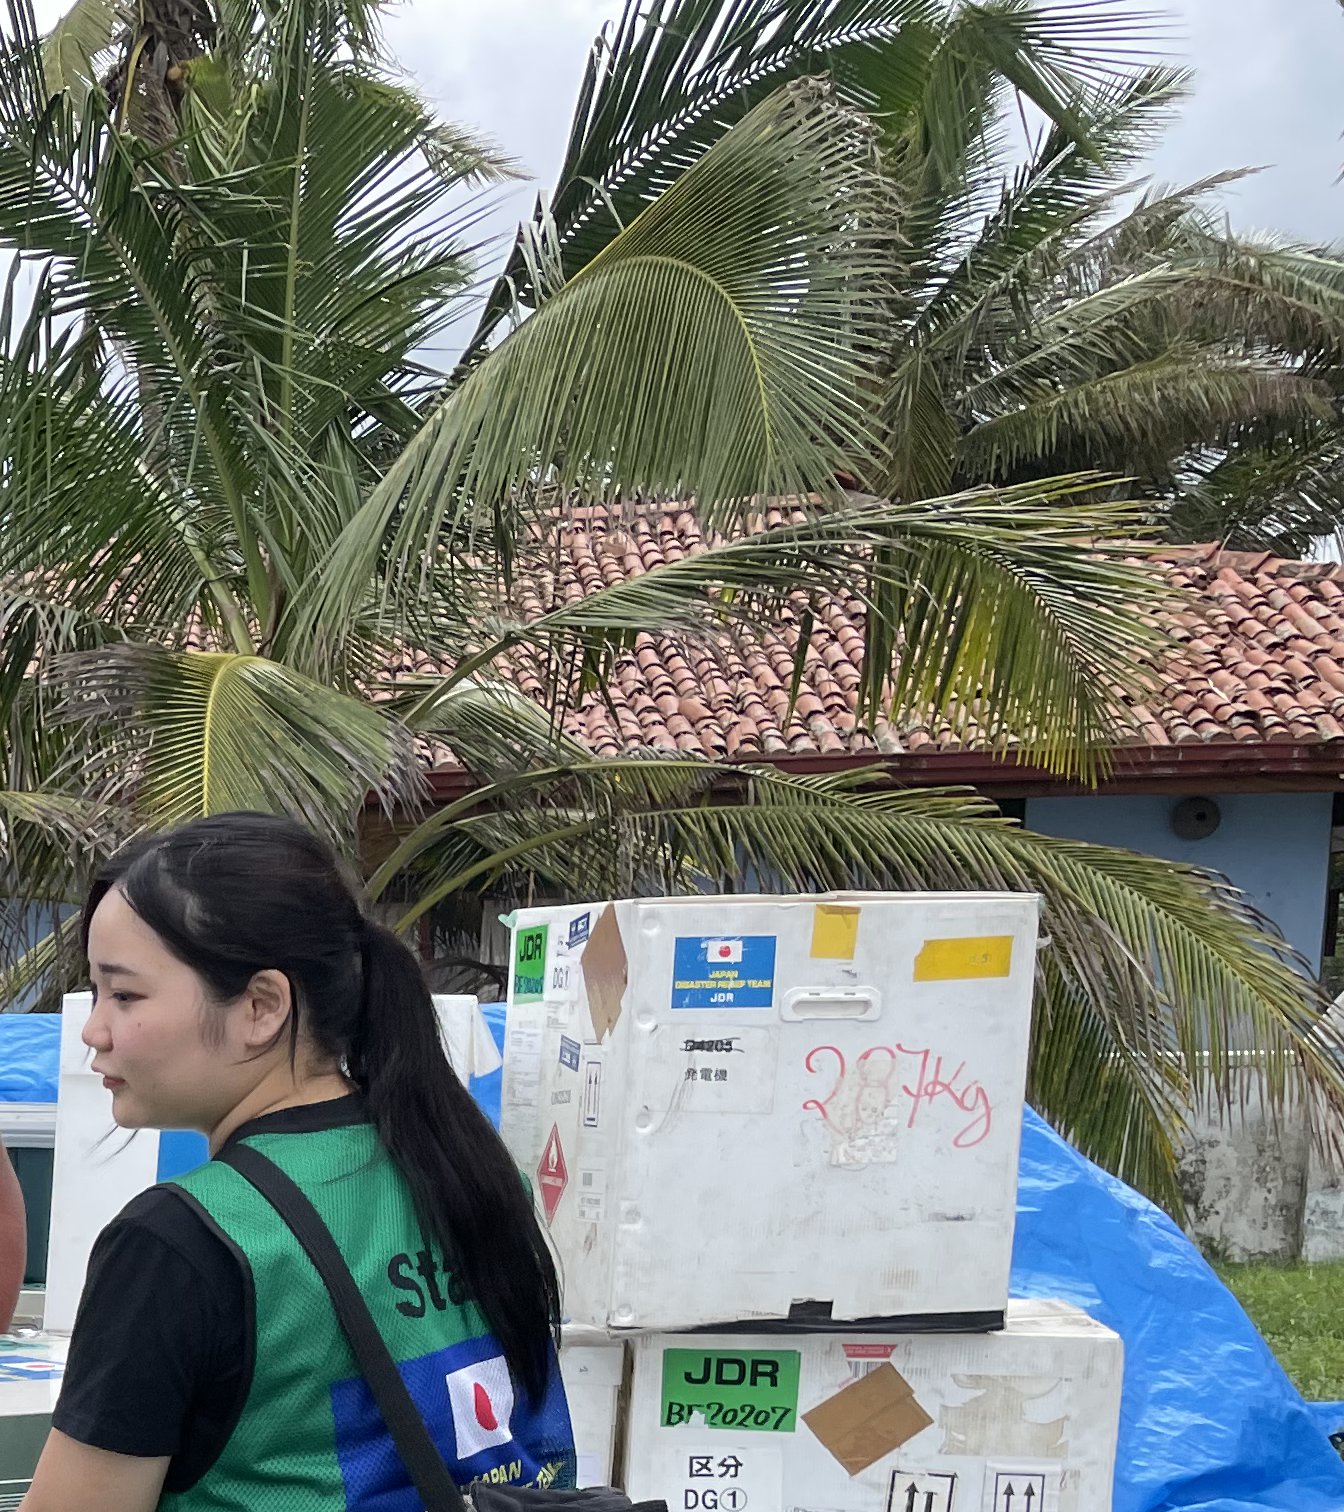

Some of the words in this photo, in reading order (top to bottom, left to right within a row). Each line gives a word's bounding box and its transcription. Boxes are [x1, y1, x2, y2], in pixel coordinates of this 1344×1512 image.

[710, 992, 734, 1003] JDR
[684, 1357, 780, 1387] JDR
[689, 1455, 744, 1478] 区分
